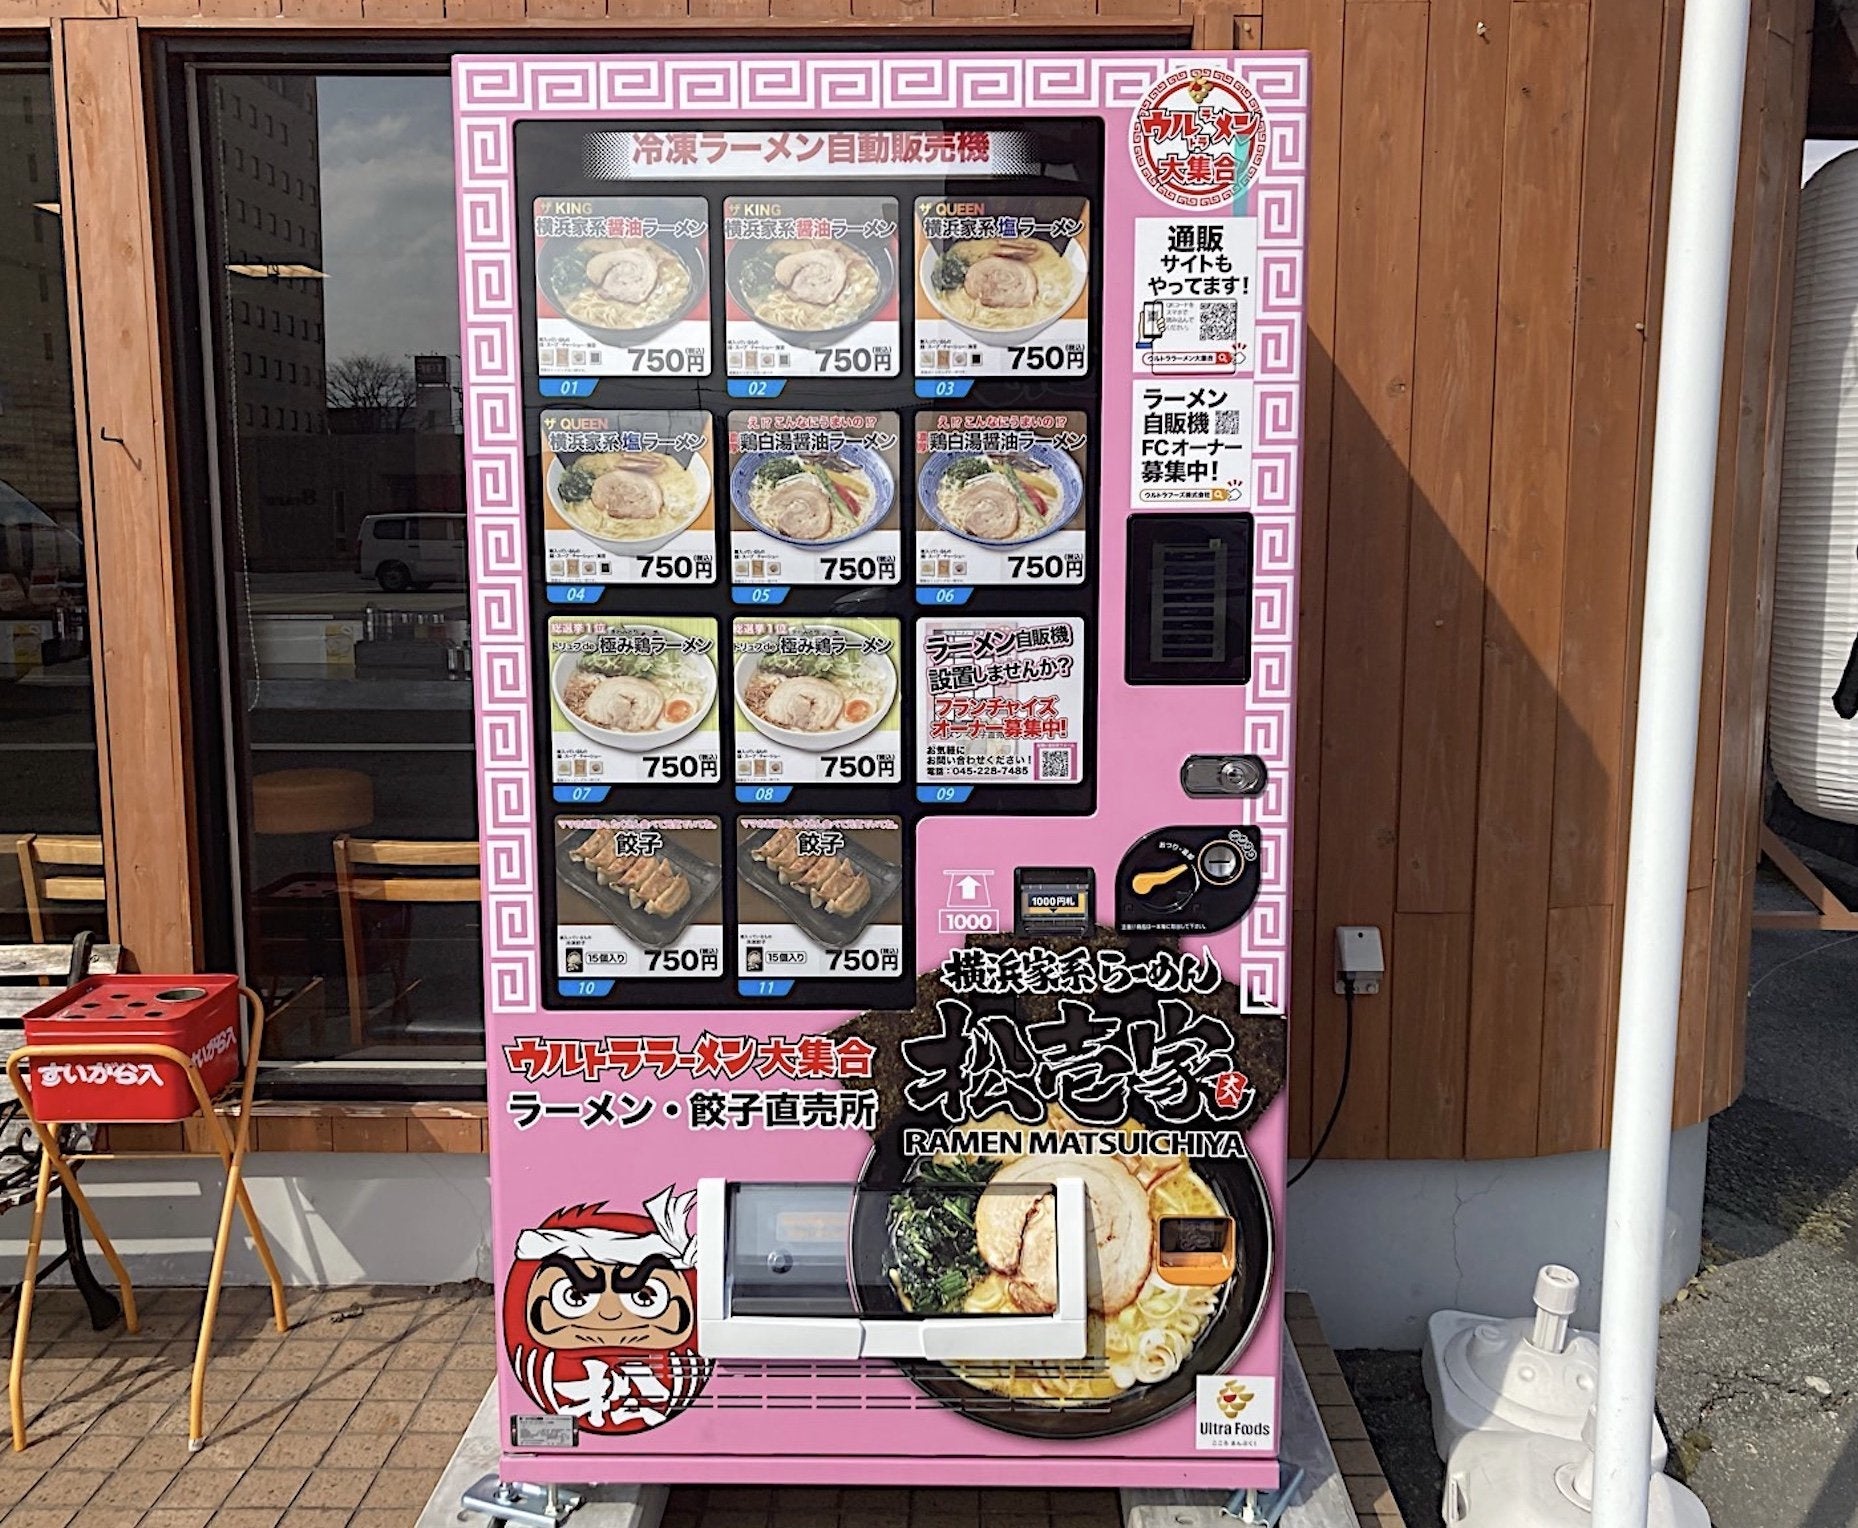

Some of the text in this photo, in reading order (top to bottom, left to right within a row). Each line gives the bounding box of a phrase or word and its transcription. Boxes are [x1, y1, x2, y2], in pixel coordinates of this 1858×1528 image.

[632, 131, 990, 165] 冷凍ラーメン自動販売機
[1158, 152, 1238, 184] 大集合
[555, 202, 593, 216] KING
[743, 203, 782, 216] KING
[919, 203, 986, 216] ザ QUEEN
[536, 217, 707, 238] 横浜家系醤油ラーメン
[725, 218, 896, 239] 横浜家系醤油ラーメン
[924, 217, 1084, 239] 横浜家系塩ラーメン
[1168, 225, 1224, 253] 通販
[1160, 254, 1232, 273] サイトも
[1148, 276, 1249, 296] やってます!
[559, 380, 579, 395] 01
[748, 381, 767, 396] 02
[936, 381, 955, 395] 03
[1143, 387, 1228, 410] ラーメン
[543, 417, 609, 431] ザ QUEEN
[1143, 411, 1210, 435] 自販機
[548, 432, 707, 452] 横浜家系塩ラーメン
[740, 431, 898, 453] 鶏白湯醤油ラーメン
[929, 431, 1087, 453] 鶏白湯醤油ラーメン
[1141, 438, 1243, 457] FCオーナー
[1141, 460, 1218, 483] 募集中!
[566, 587, 586, 601] 04
[752, 588, 770, 602] 05
[936, 588, 955, 602] 06
[599, 636, 713, 656] 極み鶏ラーメン
[779, 636, 894, 656] 極み鶏ラーメン
[925, 624, 1073, 664] ラーメン自販機
[927, 656, 1074, 694] 設置しませんか?
[934, 696, 1061, 717] フランチャイズ
[930, 719, 1068, 740] オーナー募集中!
[926, 745, 965, 755] お気軽に
[572, 788, 592, 801] 07
[755, 788, 774, 801] 08
[936, 788, 955, 801] 09
[615, 831, 663, 856] 餃子
[797, 831, 845, 856] 餃子
[1031, 895, 1076, 908] 1000円札
[945, 912, 993, 931] 1000
[588, 953, 625, 963] 15個入り
[768, 952, 805, 963] 15個入り
[577, 981, 595, 994] 10
[759, 981, 775, 994] 11
[504, 1032, 876, 1081] ウルトララーメン大集合
[37, 1061, 164, 1088] すいがら入
[507, 1089, 879, 1130] ラーメン・餃子直売所
[904, 1130, 1248, 1158] RAMEN MATSUICHIYA
[1200, 1421, 1270, 1435] Ultra Foods
